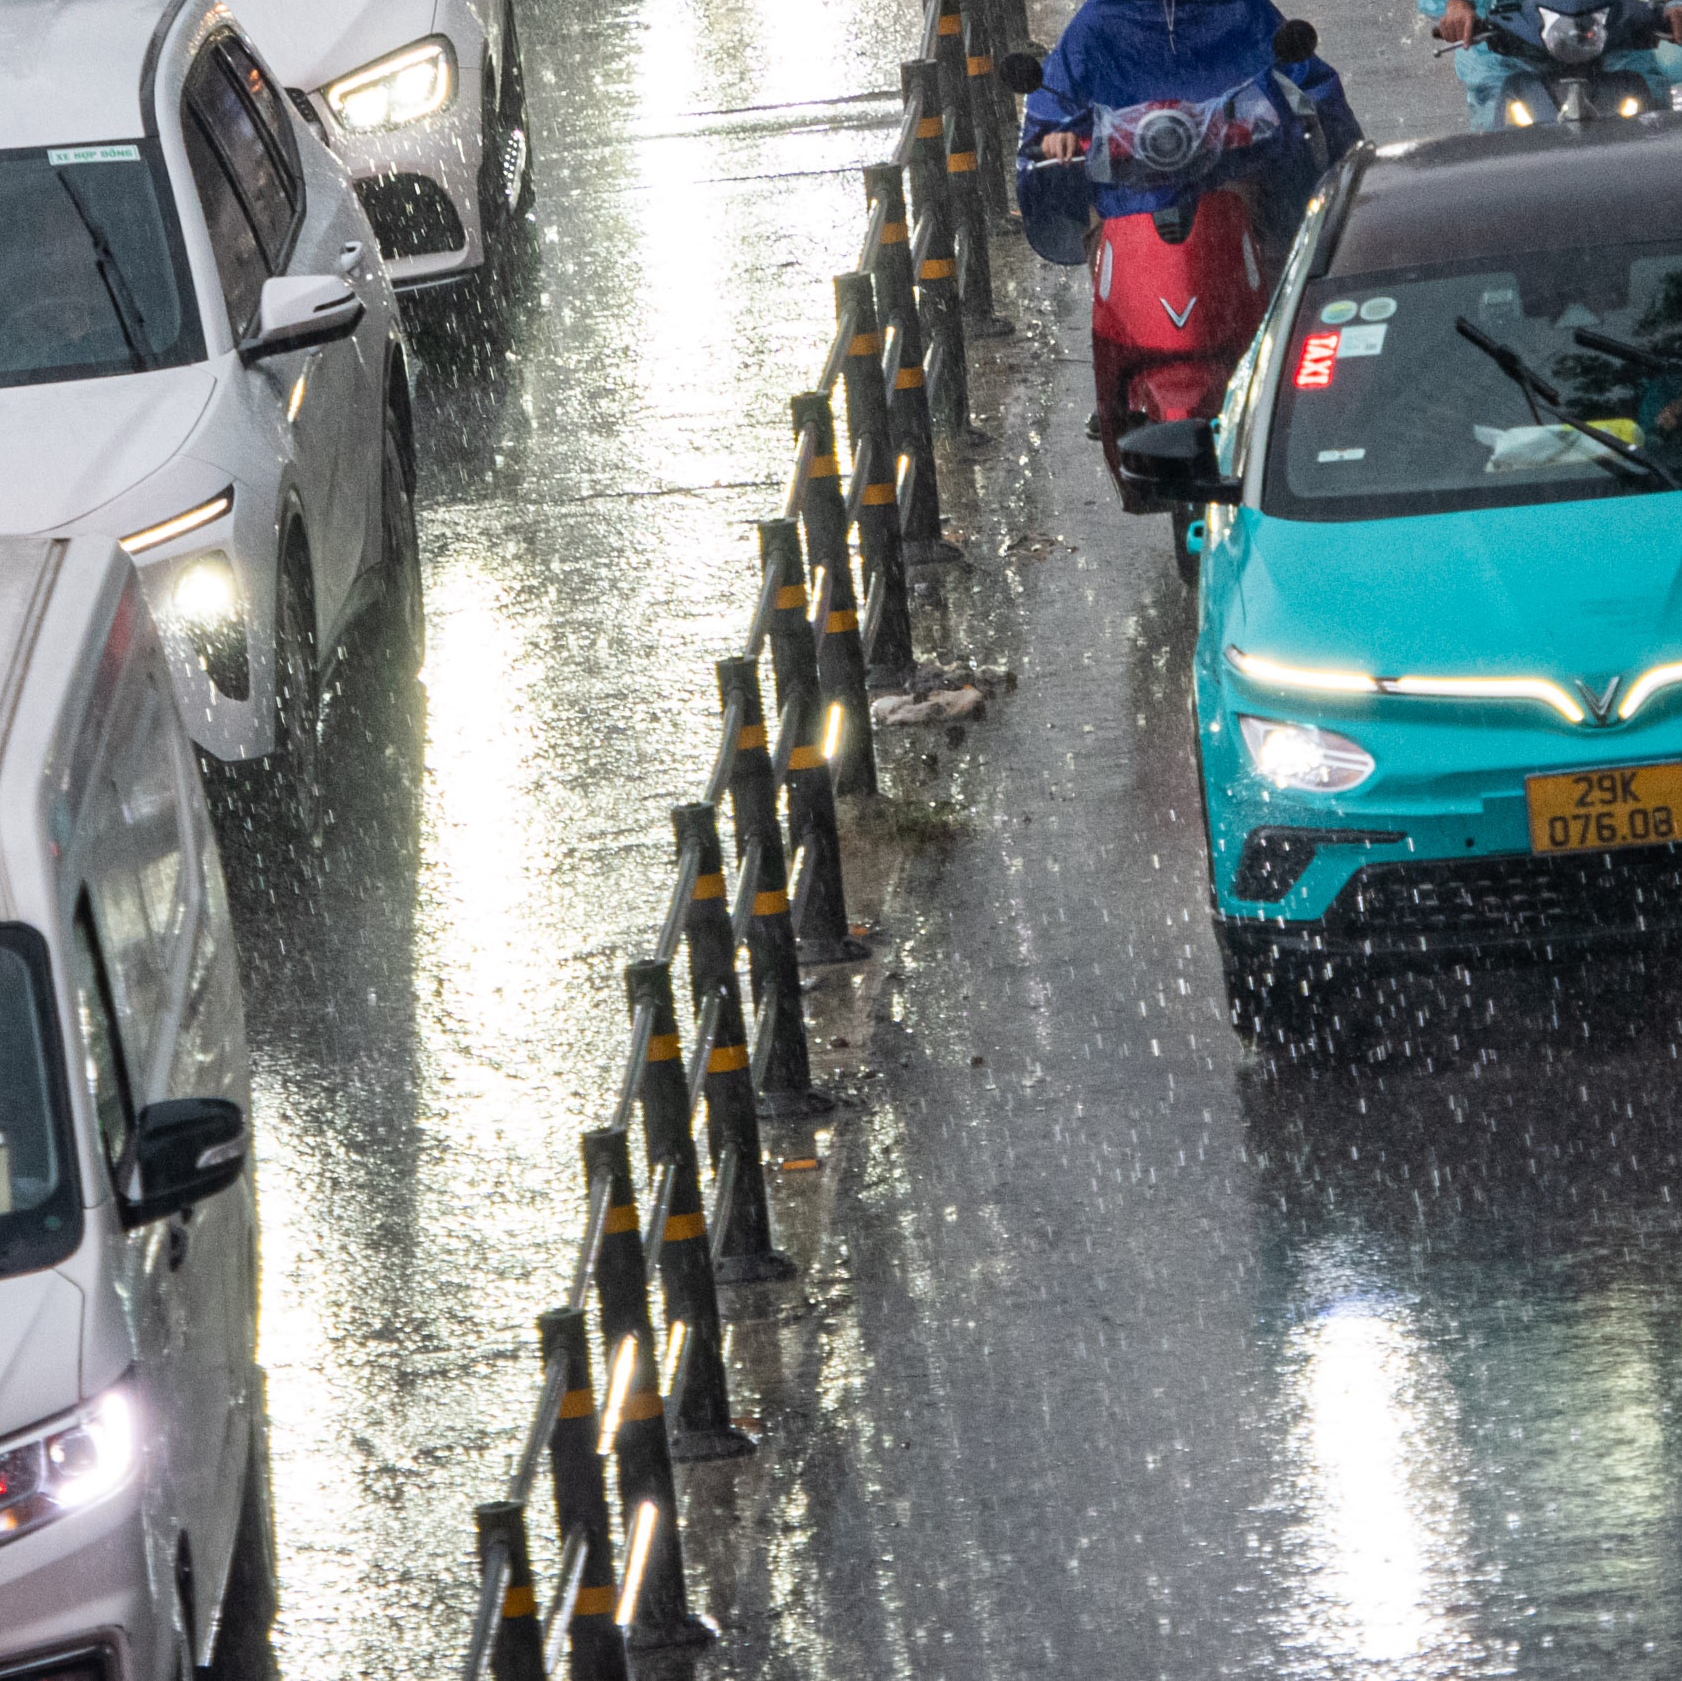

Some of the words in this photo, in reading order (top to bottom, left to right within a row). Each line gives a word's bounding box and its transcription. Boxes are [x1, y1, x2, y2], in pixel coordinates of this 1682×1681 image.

[1294, 332, 1340, 388] TAXI
[1573, 771, 1642, 808] 29K
[1547, 805, 1675, 848] 076.08
